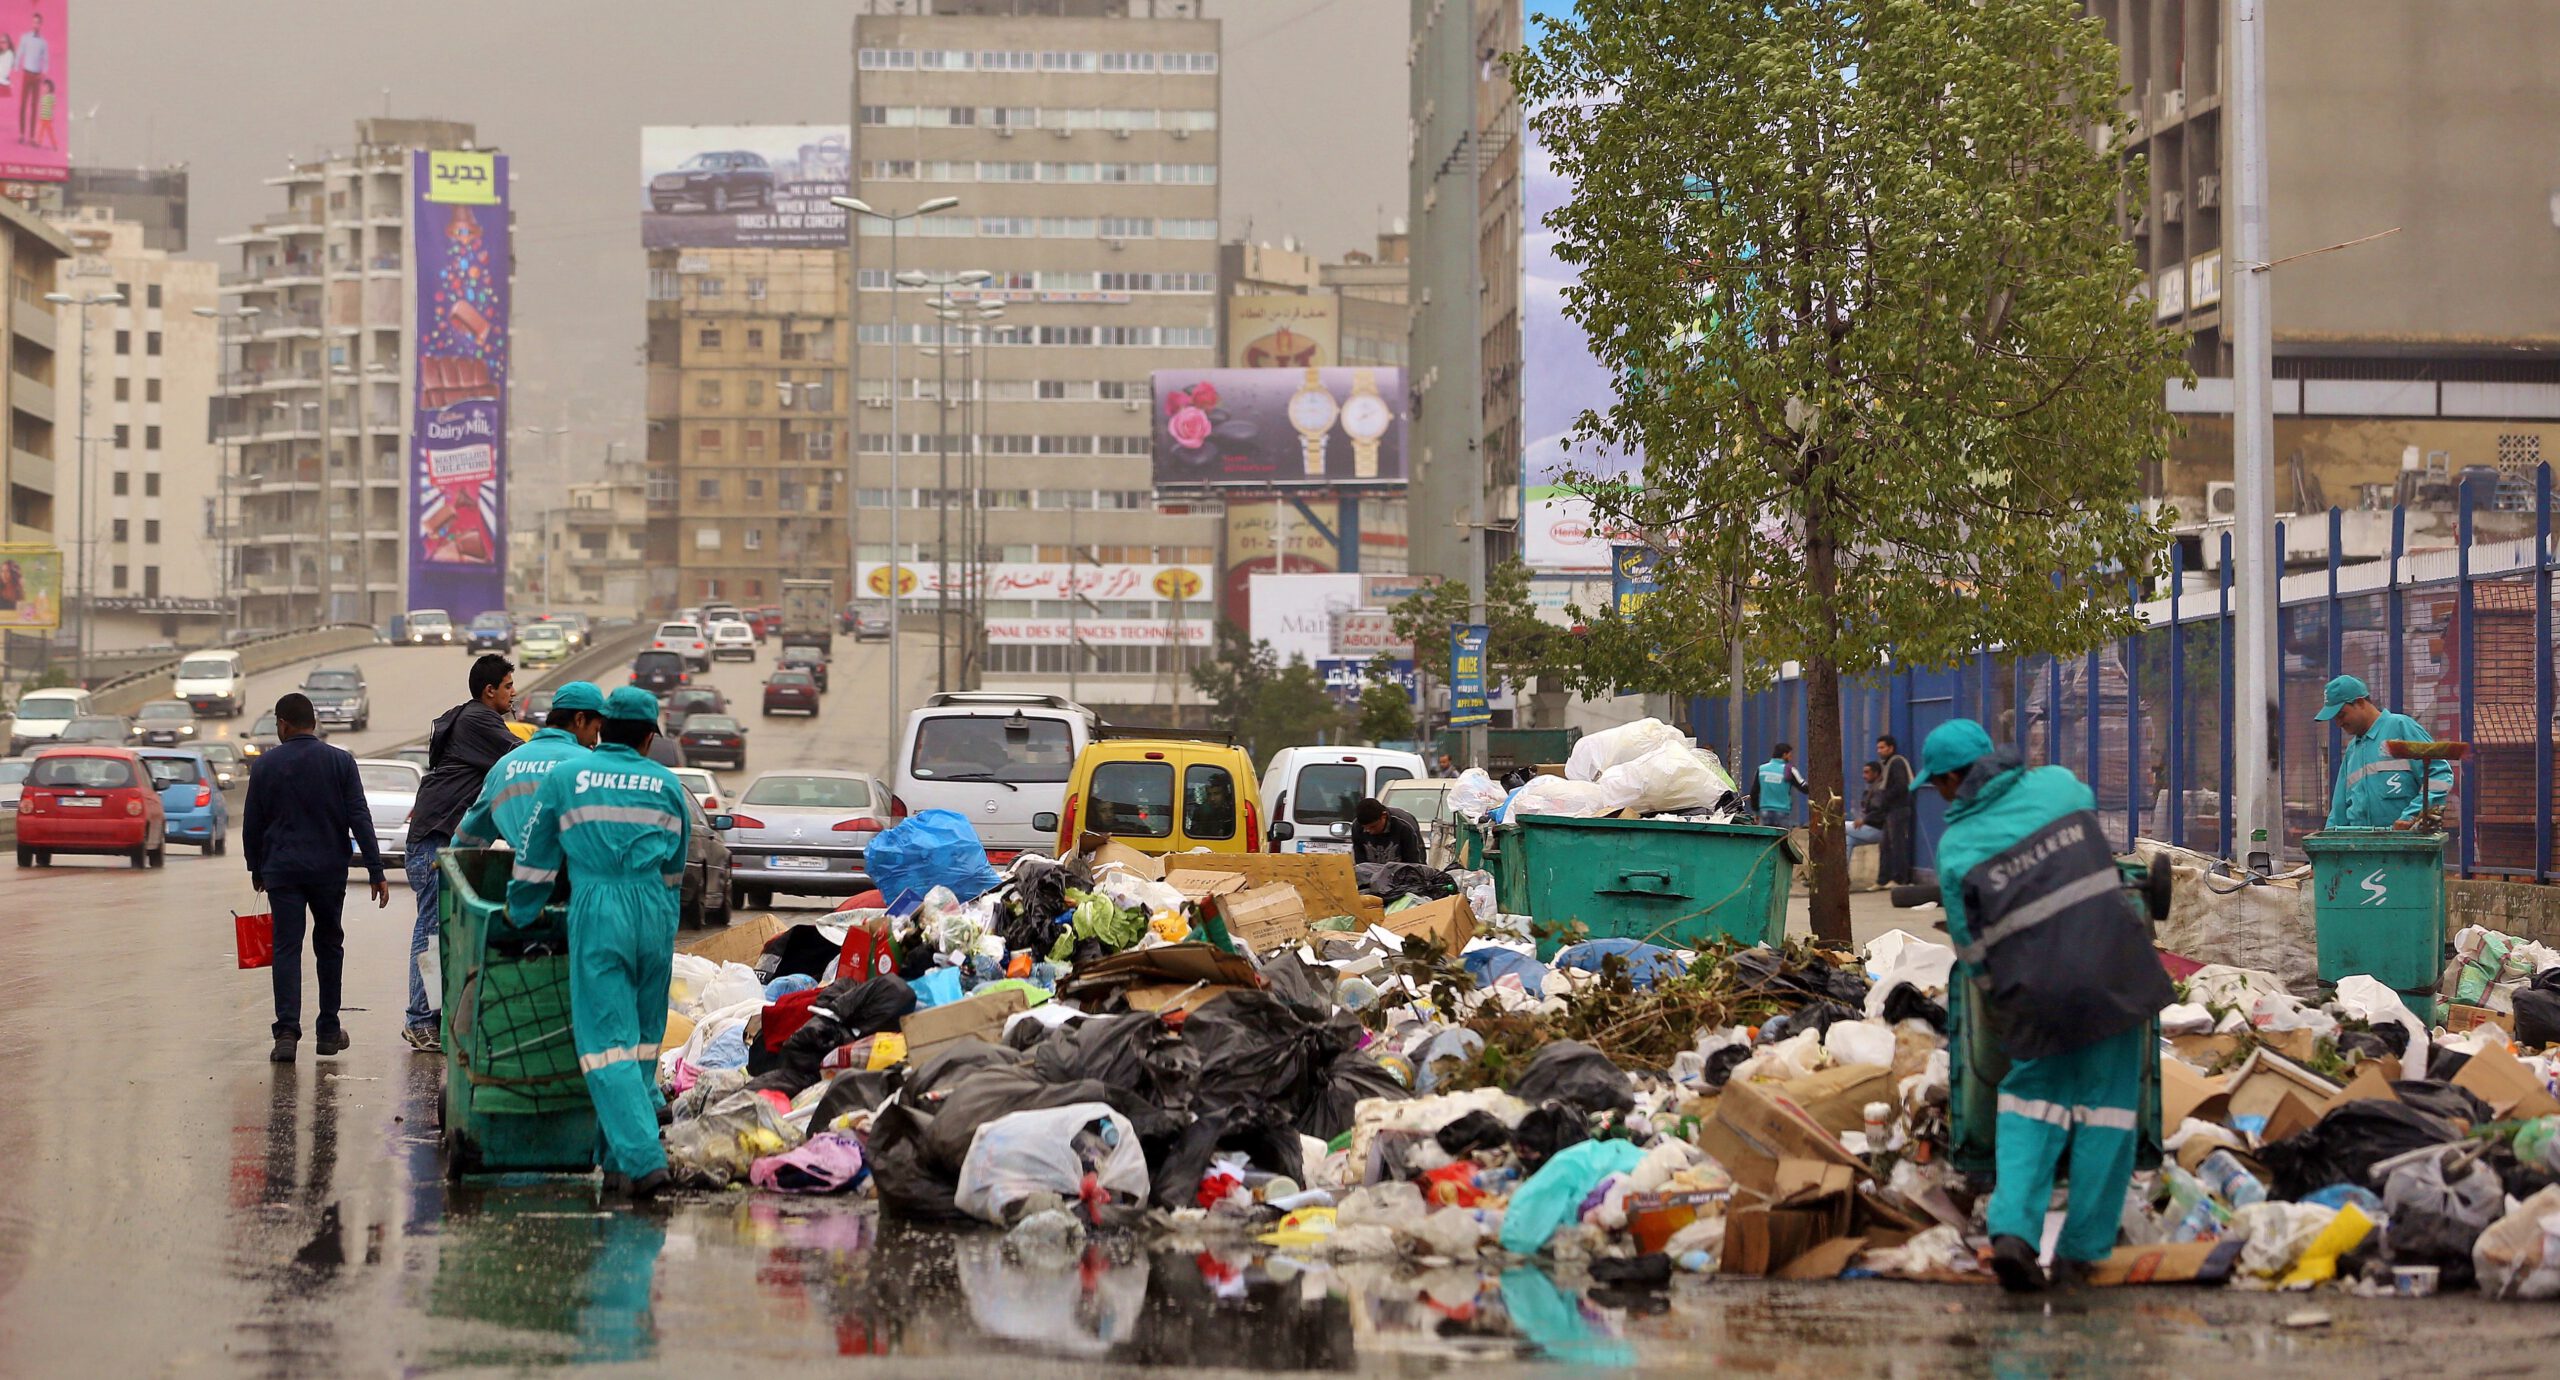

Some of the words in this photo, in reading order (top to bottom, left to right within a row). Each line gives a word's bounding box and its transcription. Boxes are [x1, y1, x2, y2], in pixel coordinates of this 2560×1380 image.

[777, 200, 806, 214] WHEN
[769, 213, 779, 229] A
[780, 213, 803, 229] NEW
[804, 213, 847, 229] CONCEPT
[427, 421, 465, 441] Dairy
[464, 417, 494, 437] Milk
[1026, 625, 1051, 639] DES
[575, 769, 664, 795] SUKLEEN
[1988, 823, 2086, 892] SUKLEEN
